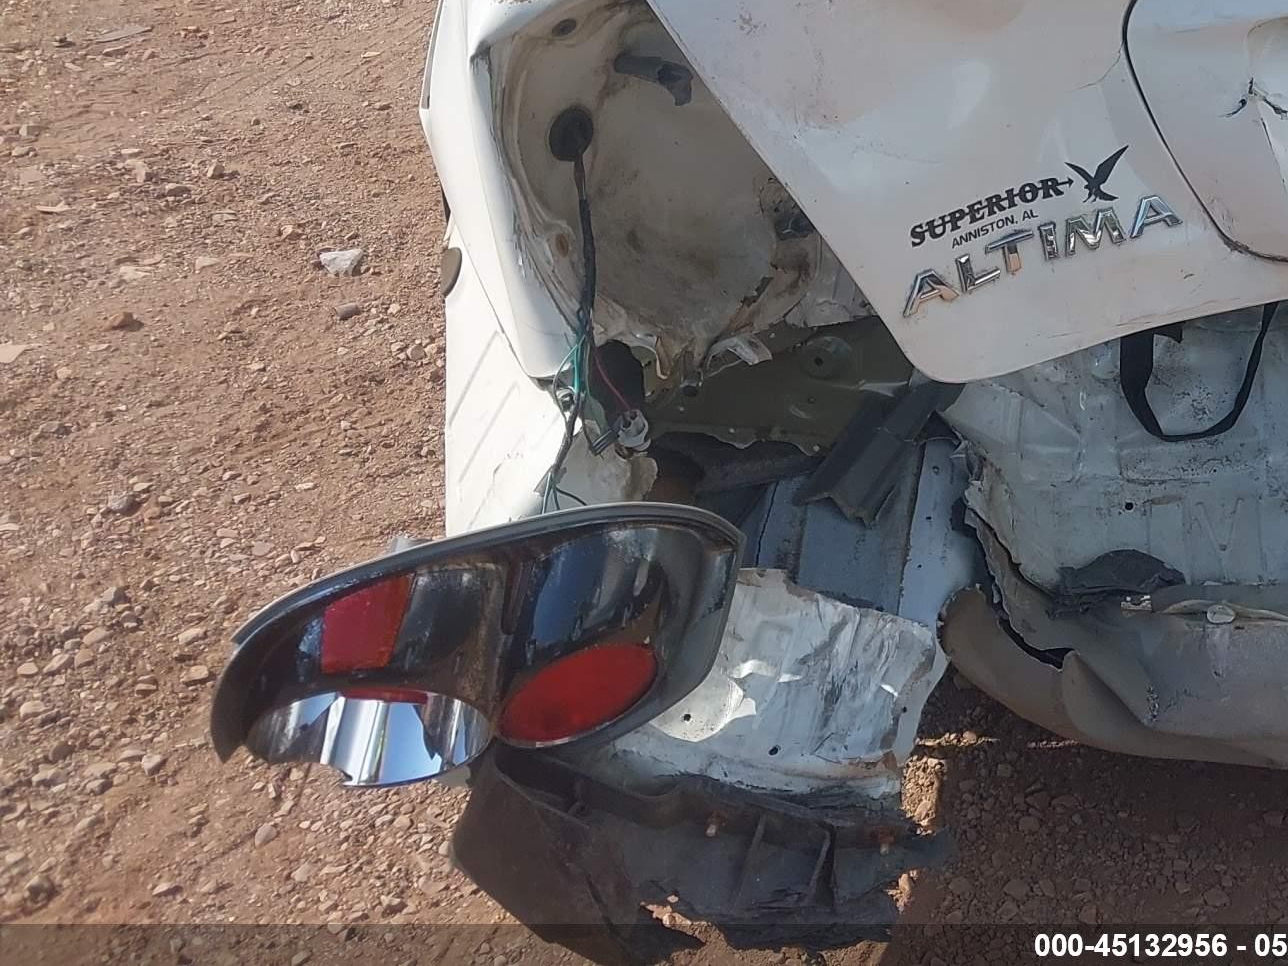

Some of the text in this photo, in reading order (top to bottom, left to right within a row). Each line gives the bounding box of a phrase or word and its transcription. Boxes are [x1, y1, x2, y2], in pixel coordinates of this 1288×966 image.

[910, 176, 1066, 248] SUPERIOR
[951, 210, 1039, 249] ANNISTON, AL
[903, 194, 1184, 318] ALTIMA
